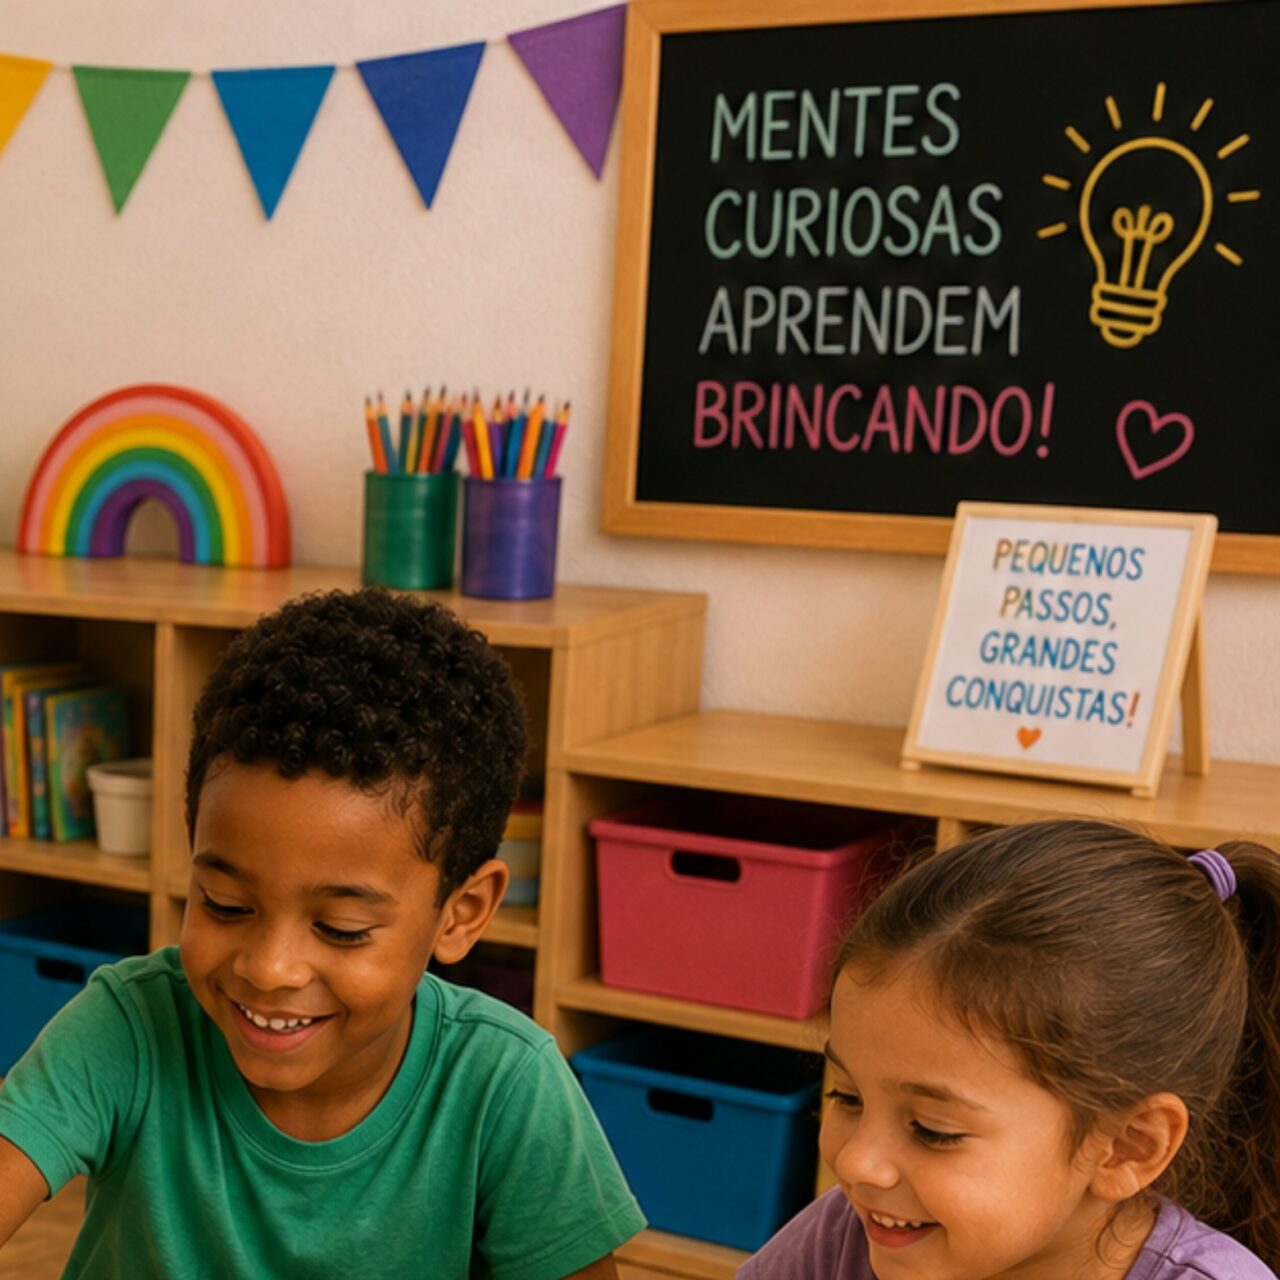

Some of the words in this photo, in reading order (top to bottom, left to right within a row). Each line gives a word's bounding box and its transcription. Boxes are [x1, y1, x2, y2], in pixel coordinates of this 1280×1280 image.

[710, 83, 960, 162] MENTES
[705, 184, 1003, 259] CURIOSAS
[699, 285, 1021, 356] APRENDEM
[693, 380, 1055, 458] BRINCANDO!
[993, 538, 1145, 580] PEQUENOS
[999, 585, 1117, 631] PASSOS,
[980, 630, 1118, 675] GRANDES
[946, 674, 1141, 728] CONQUISTAS!
